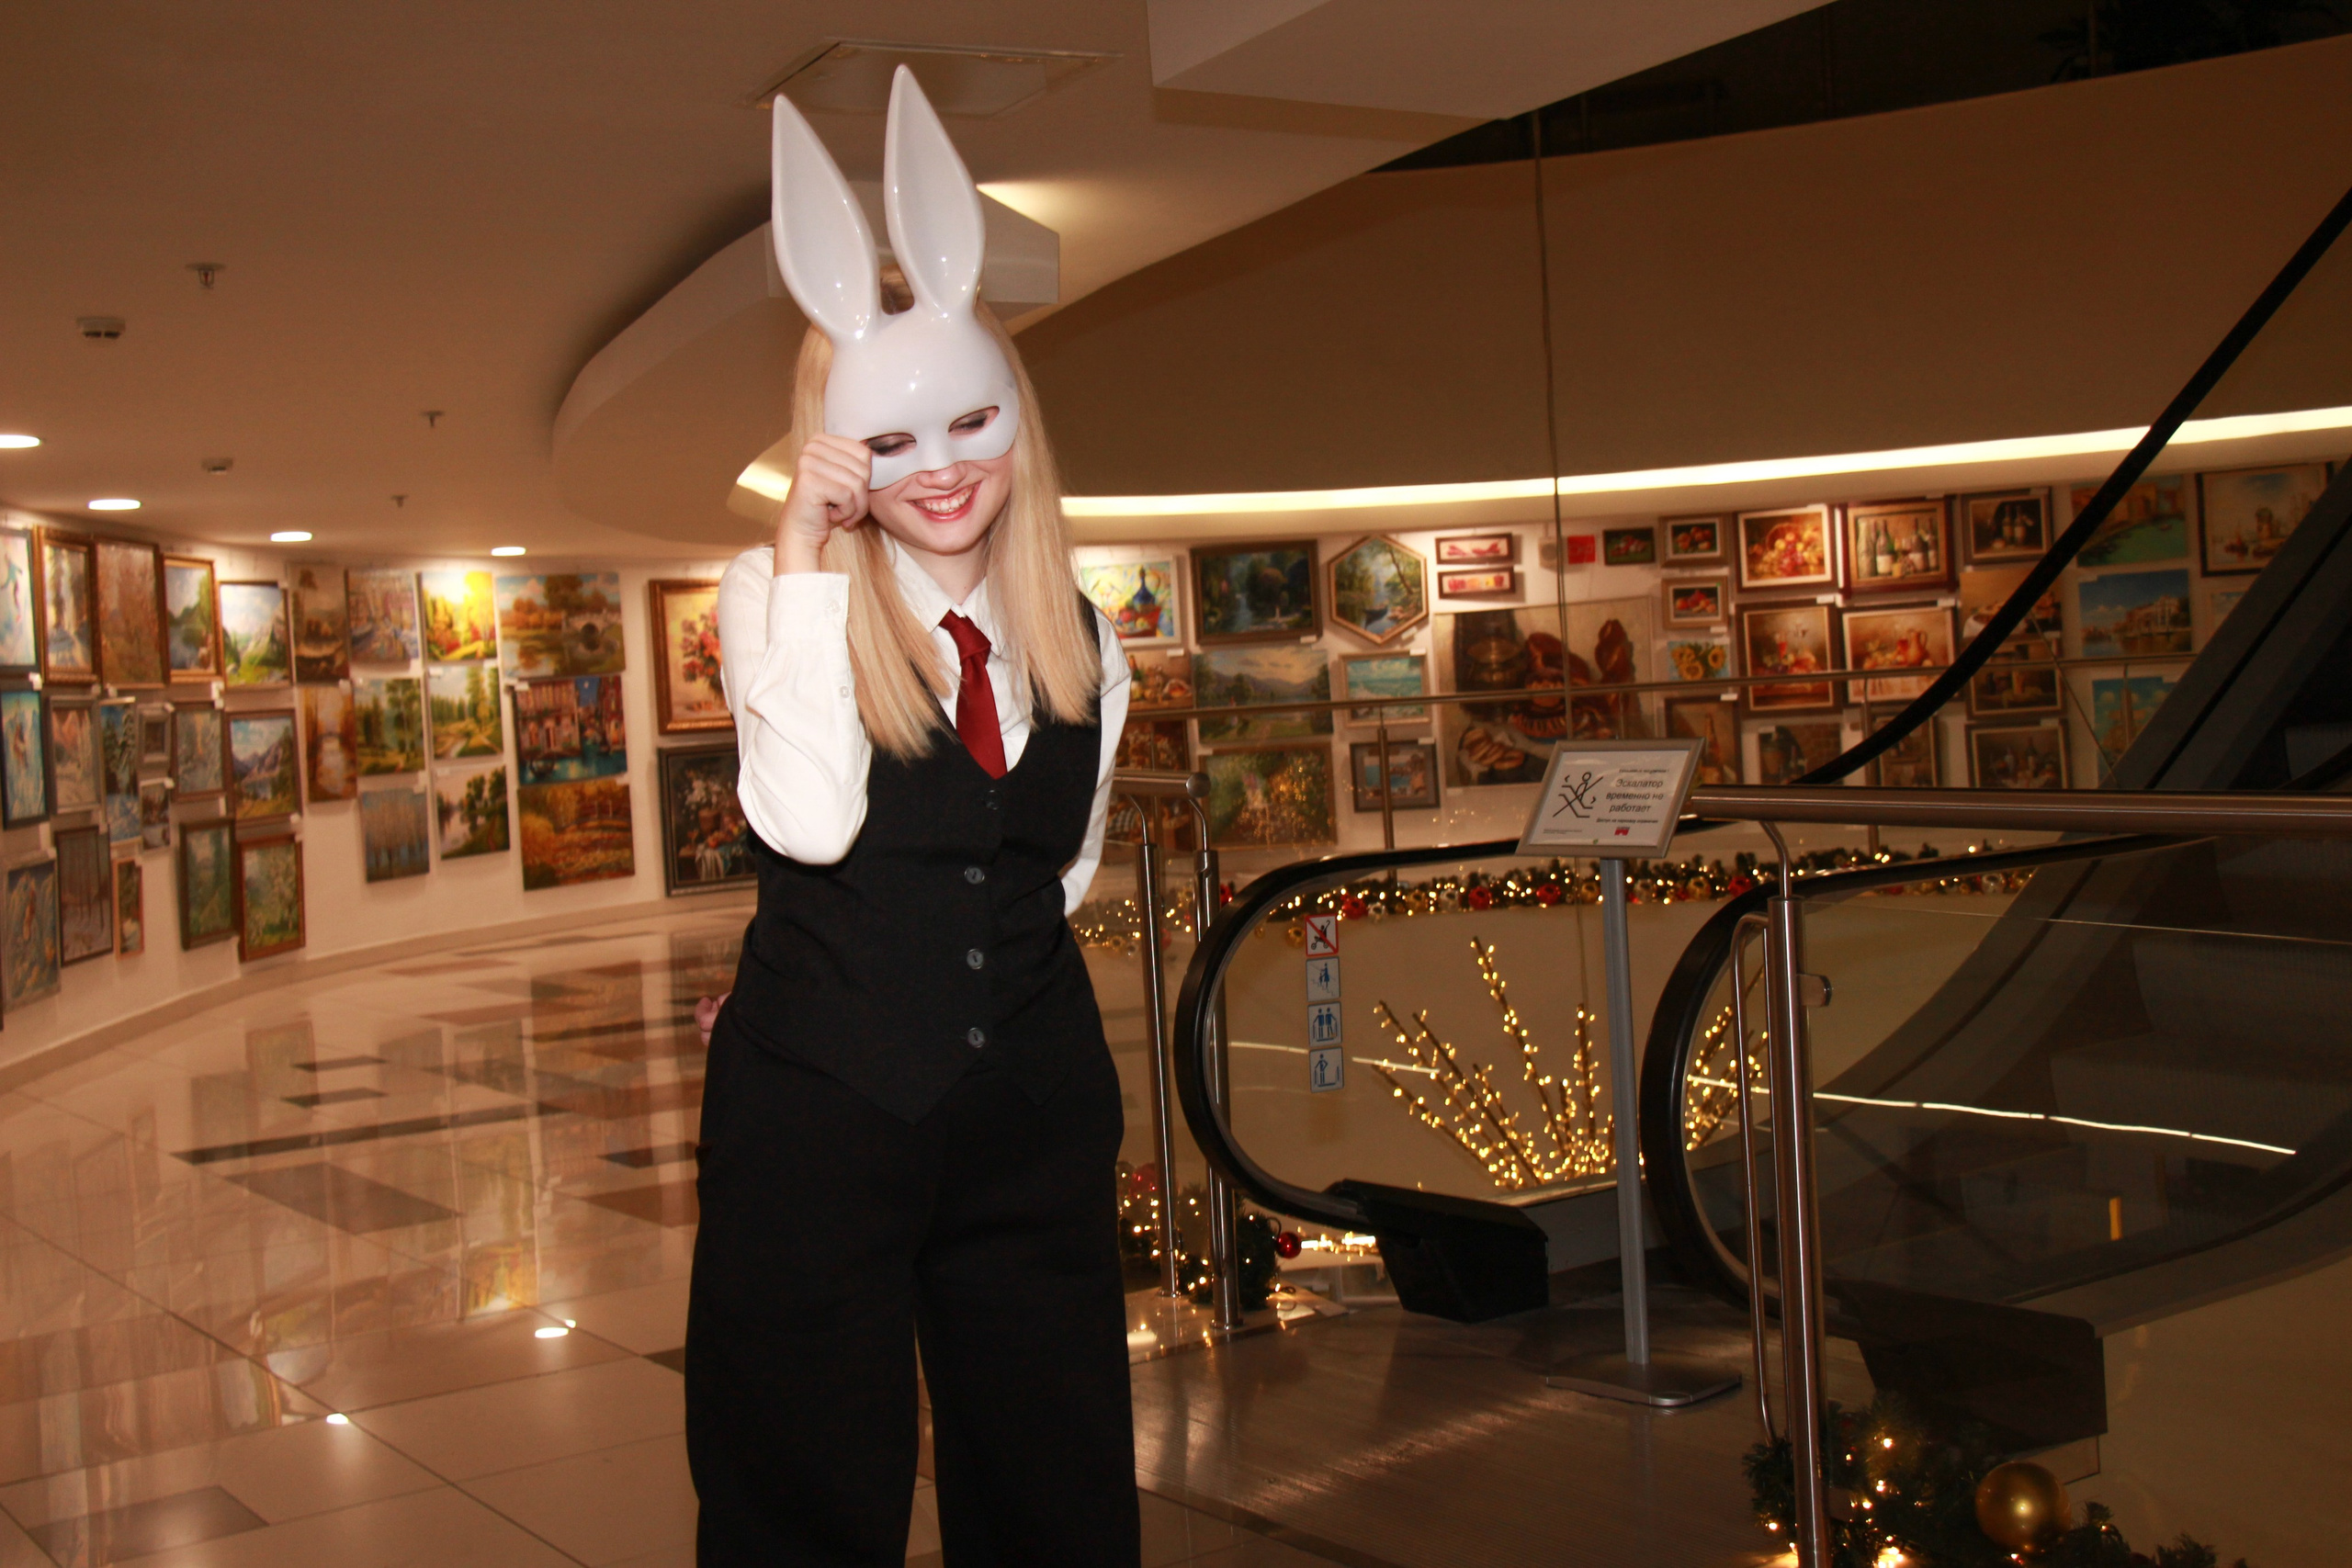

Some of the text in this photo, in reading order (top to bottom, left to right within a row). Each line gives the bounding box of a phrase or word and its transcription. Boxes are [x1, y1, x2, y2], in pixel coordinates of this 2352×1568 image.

[1615, 778, 1663, 789] Эскалатор
[1606, 793, 1650, 801] временно
[1609, 803, 1652, 813] работает
